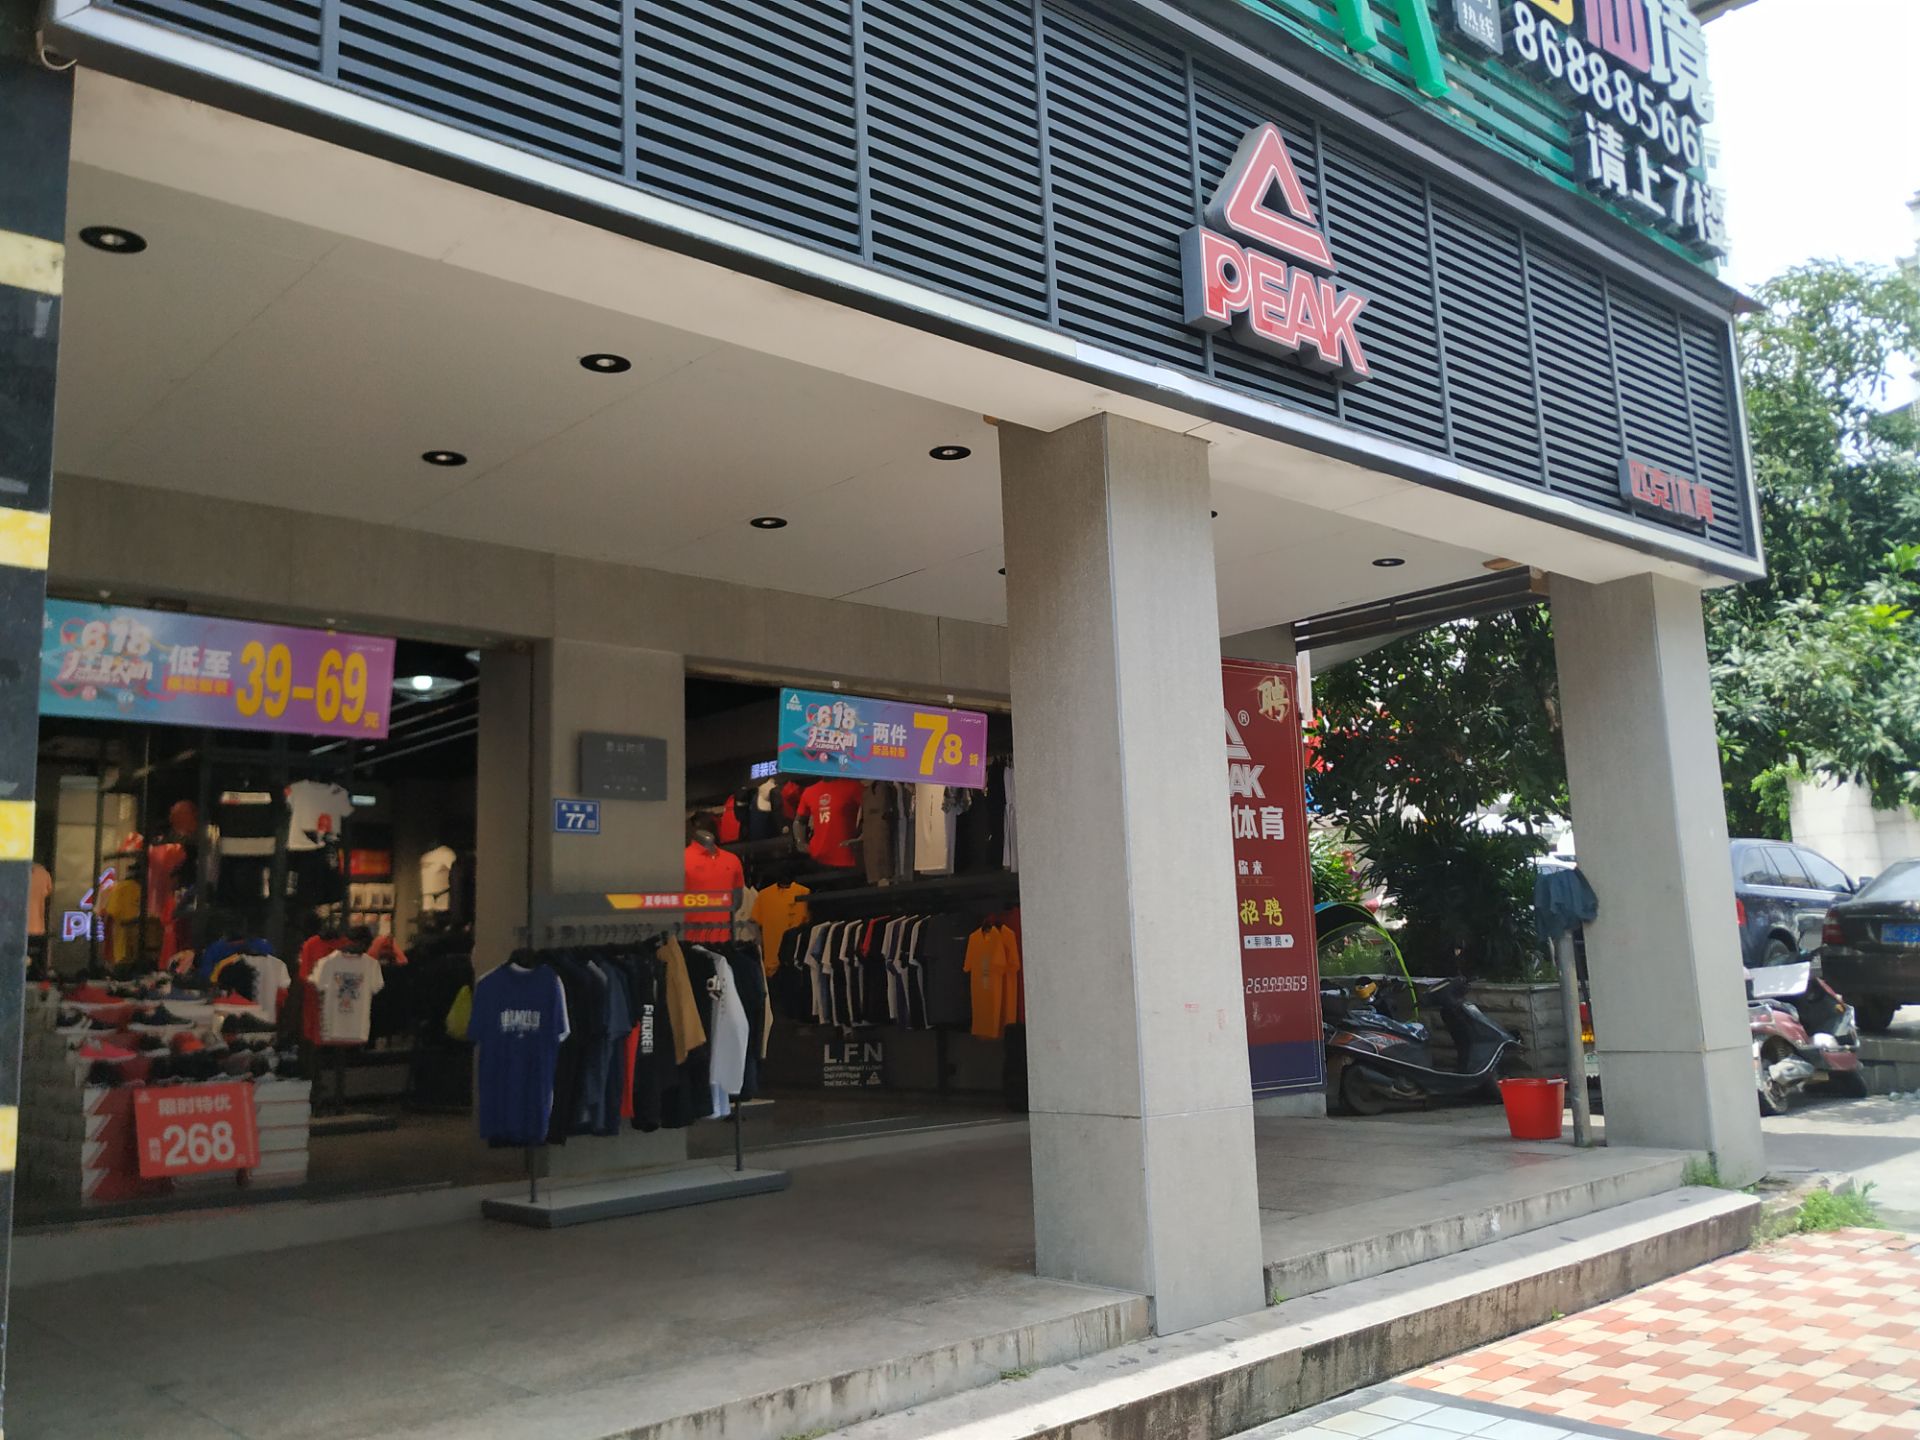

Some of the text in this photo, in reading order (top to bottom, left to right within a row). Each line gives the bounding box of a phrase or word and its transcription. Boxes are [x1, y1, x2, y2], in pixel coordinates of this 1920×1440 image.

[1462, 3, 1497, 44] 热线
[1515, 1, 1701, 167] 86888566
[1585, 112, 1725, 248] 请上7楼
[1199, 226, 1373, 378] PEAK
[168, 644, 232, 679] 低至
[872, 722, 907, 746] 两件
[565, 812, 586, 829] 77
[1232, 804, 1285, 840] 体育
[683, 893, 709, 907] 69
[1240, 897, 1284, 927] 招聘
[163, 1121, 236, 1167] 268
